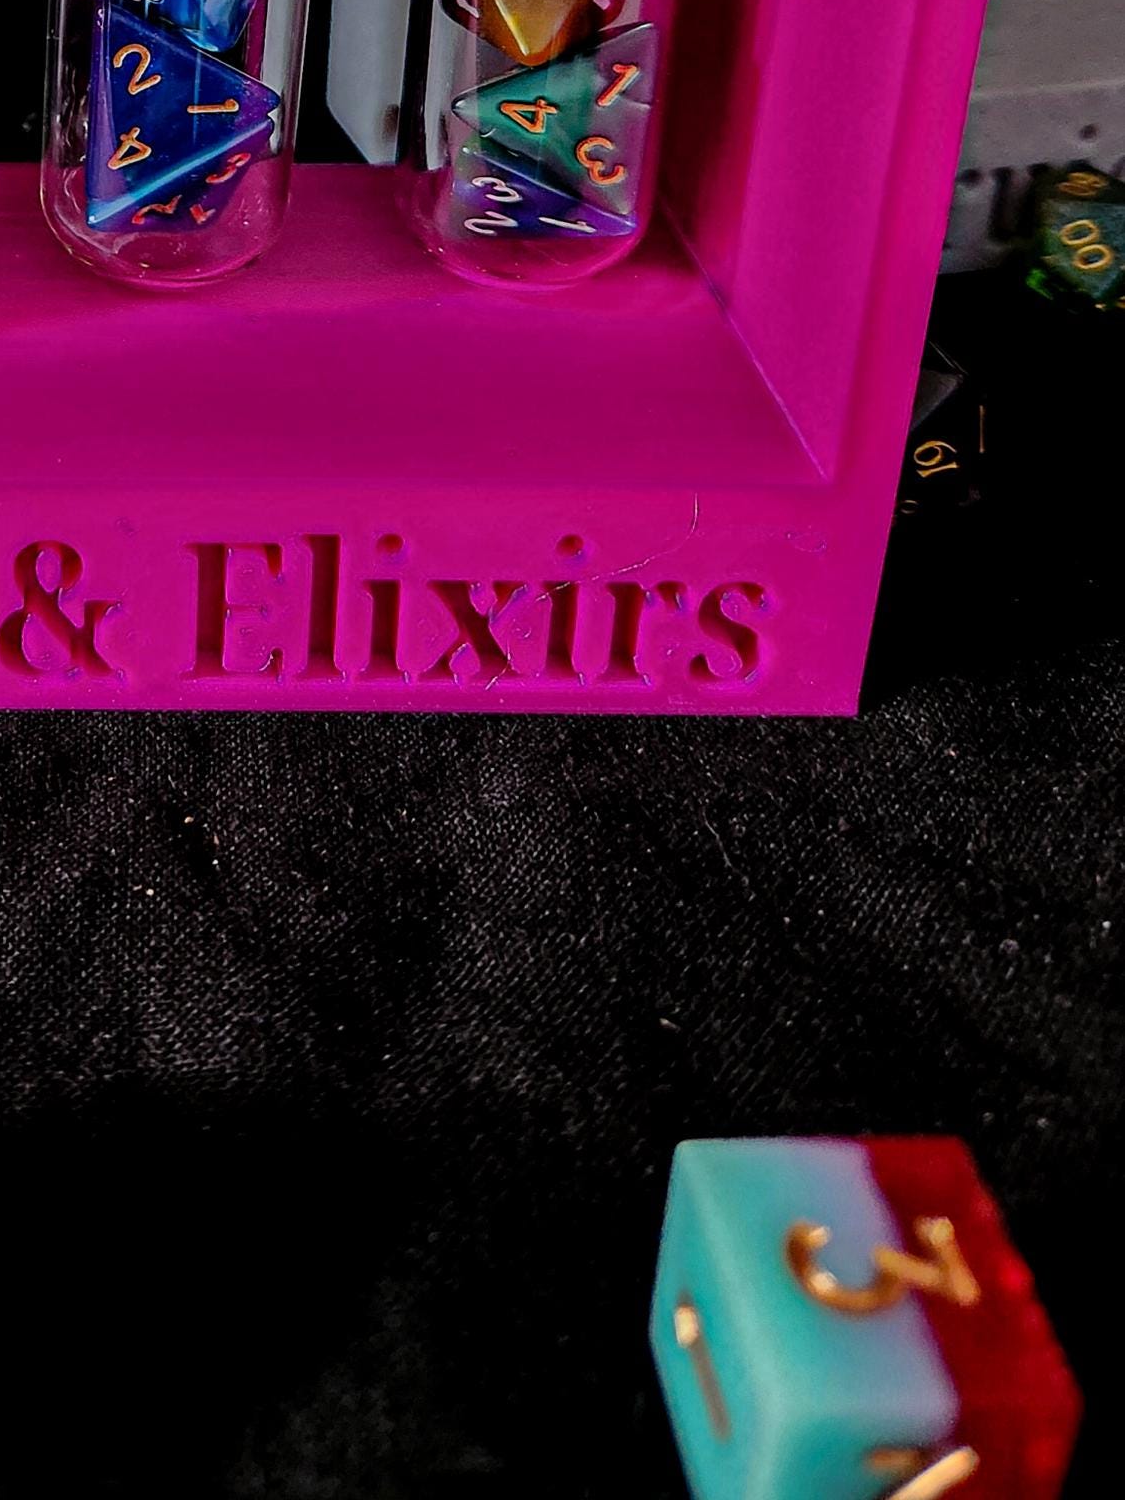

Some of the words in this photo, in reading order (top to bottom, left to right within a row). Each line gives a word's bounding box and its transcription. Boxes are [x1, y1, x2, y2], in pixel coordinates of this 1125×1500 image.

[113, 43, 162, 96] 2
[596, 63, 640, 108] 1
[500, 97, 558, 134] 4
[107, 126, 152, 170] 4
[576, 136, 625, 186] 3
[179, 532, 771, 688] Elixirs
